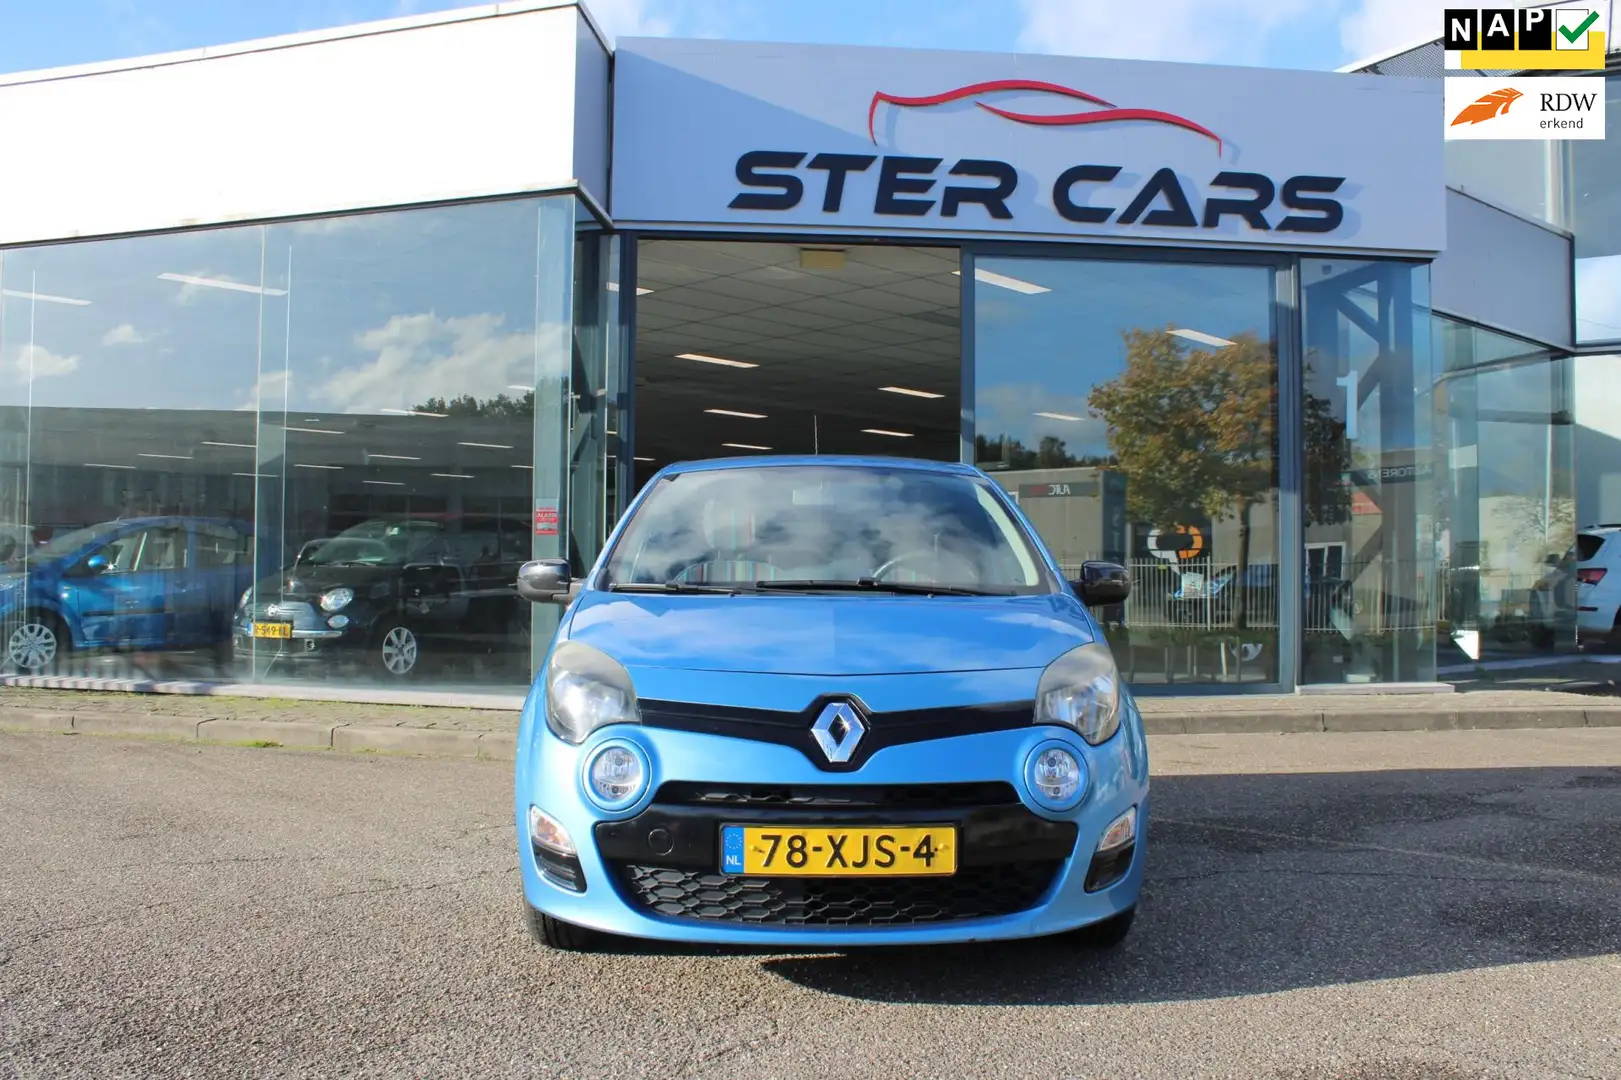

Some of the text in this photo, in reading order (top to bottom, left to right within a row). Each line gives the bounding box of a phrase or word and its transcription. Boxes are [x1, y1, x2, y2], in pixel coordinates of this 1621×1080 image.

[727, 151, 1346, 233] STER CARS
[726, 855, 742, 866] NL
[760, 834, 936, 868] 78-XJS-4
